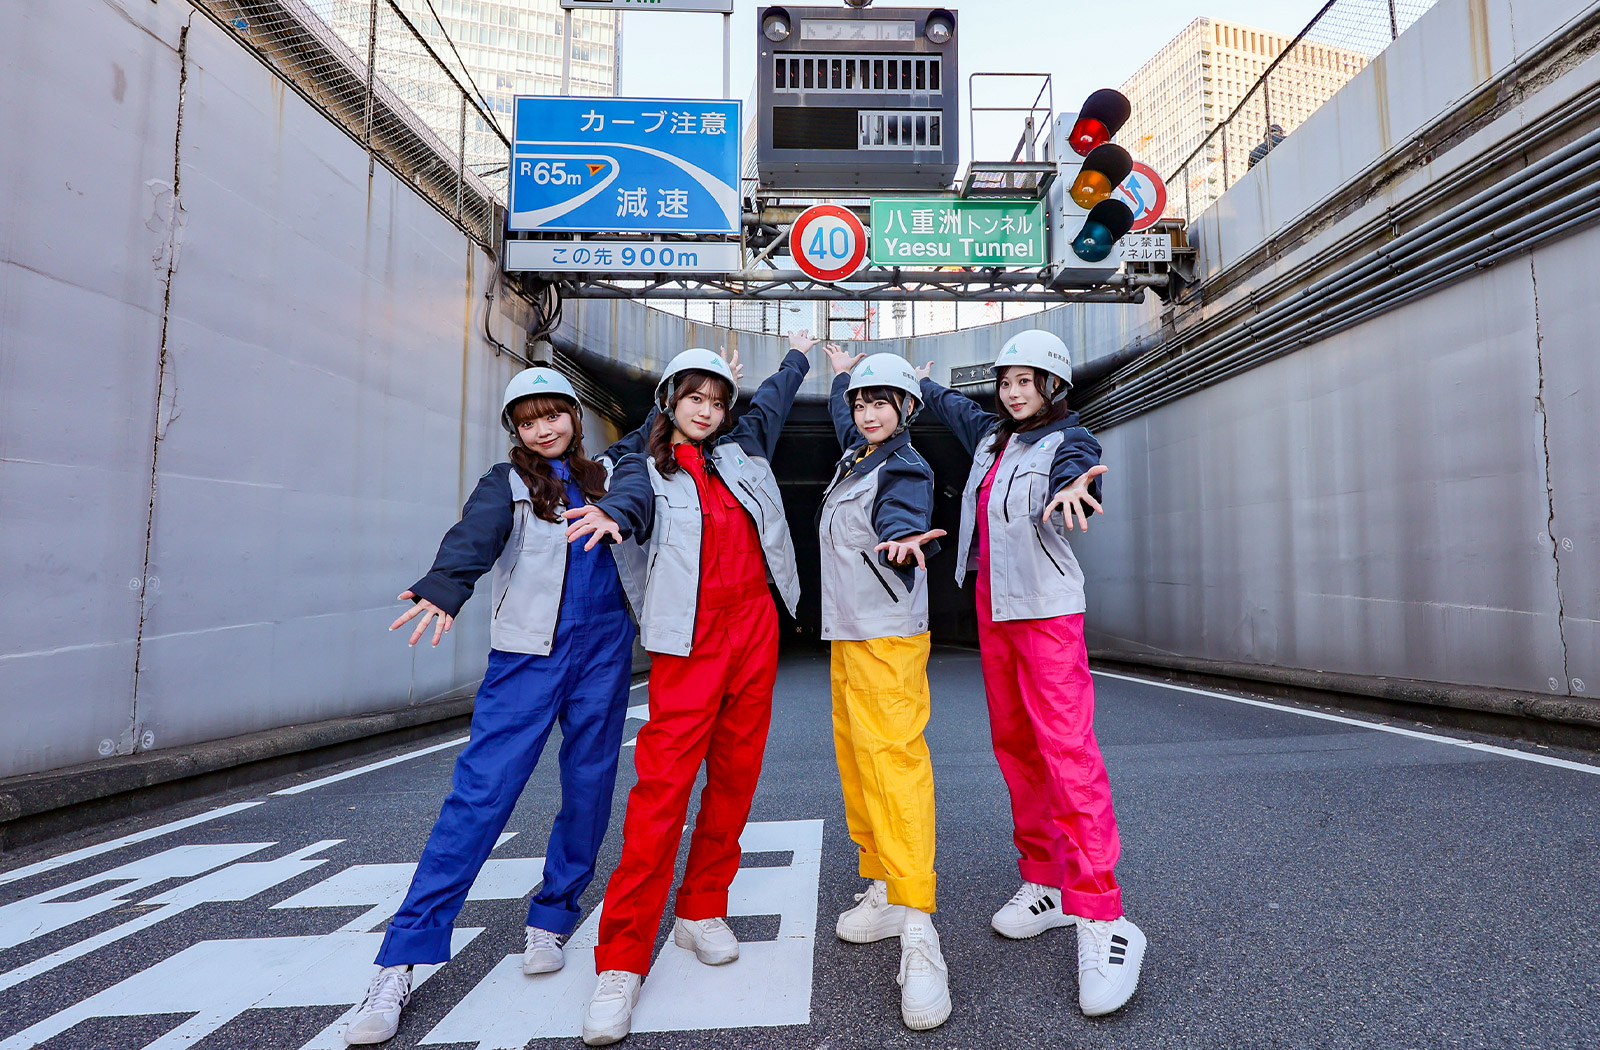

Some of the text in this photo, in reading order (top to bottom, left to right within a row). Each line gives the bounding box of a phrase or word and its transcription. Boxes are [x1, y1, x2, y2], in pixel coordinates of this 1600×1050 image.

[580, 110, 727, 135] カーブ注意
[616, 187, 689, 219] 減速
[884, 208, 1033, 236] 八重洲トンネル
[808, 227, 849, 260] 40
[883, 237, 1034, 257] Yaesu Tunnel
